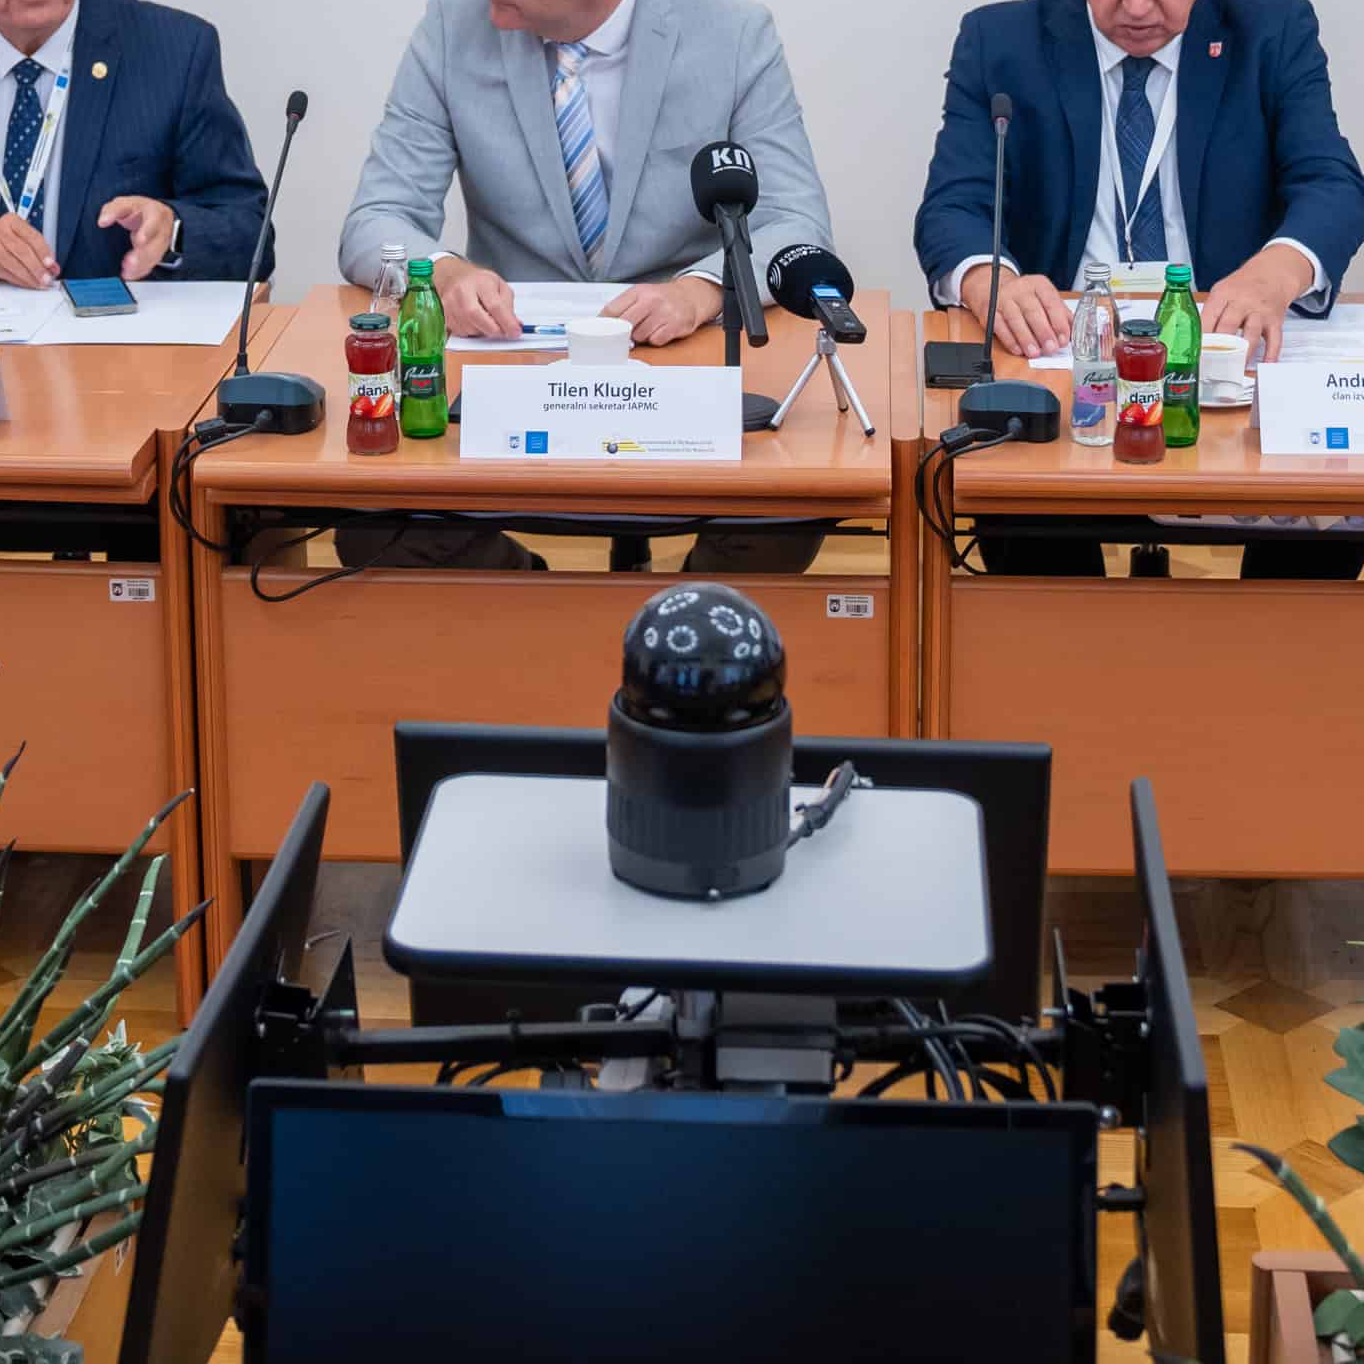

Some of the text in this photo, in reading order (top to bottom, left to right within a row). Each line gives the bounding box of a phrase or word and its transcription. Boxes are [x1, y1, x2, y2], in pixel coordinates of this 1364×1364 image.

[357, 384, 389, 396] dana
[547, 382, 655, 401] Tilen Klugler
[542, 401, 587, 412] generalni
[588, 401, 627, 411] sekretar
